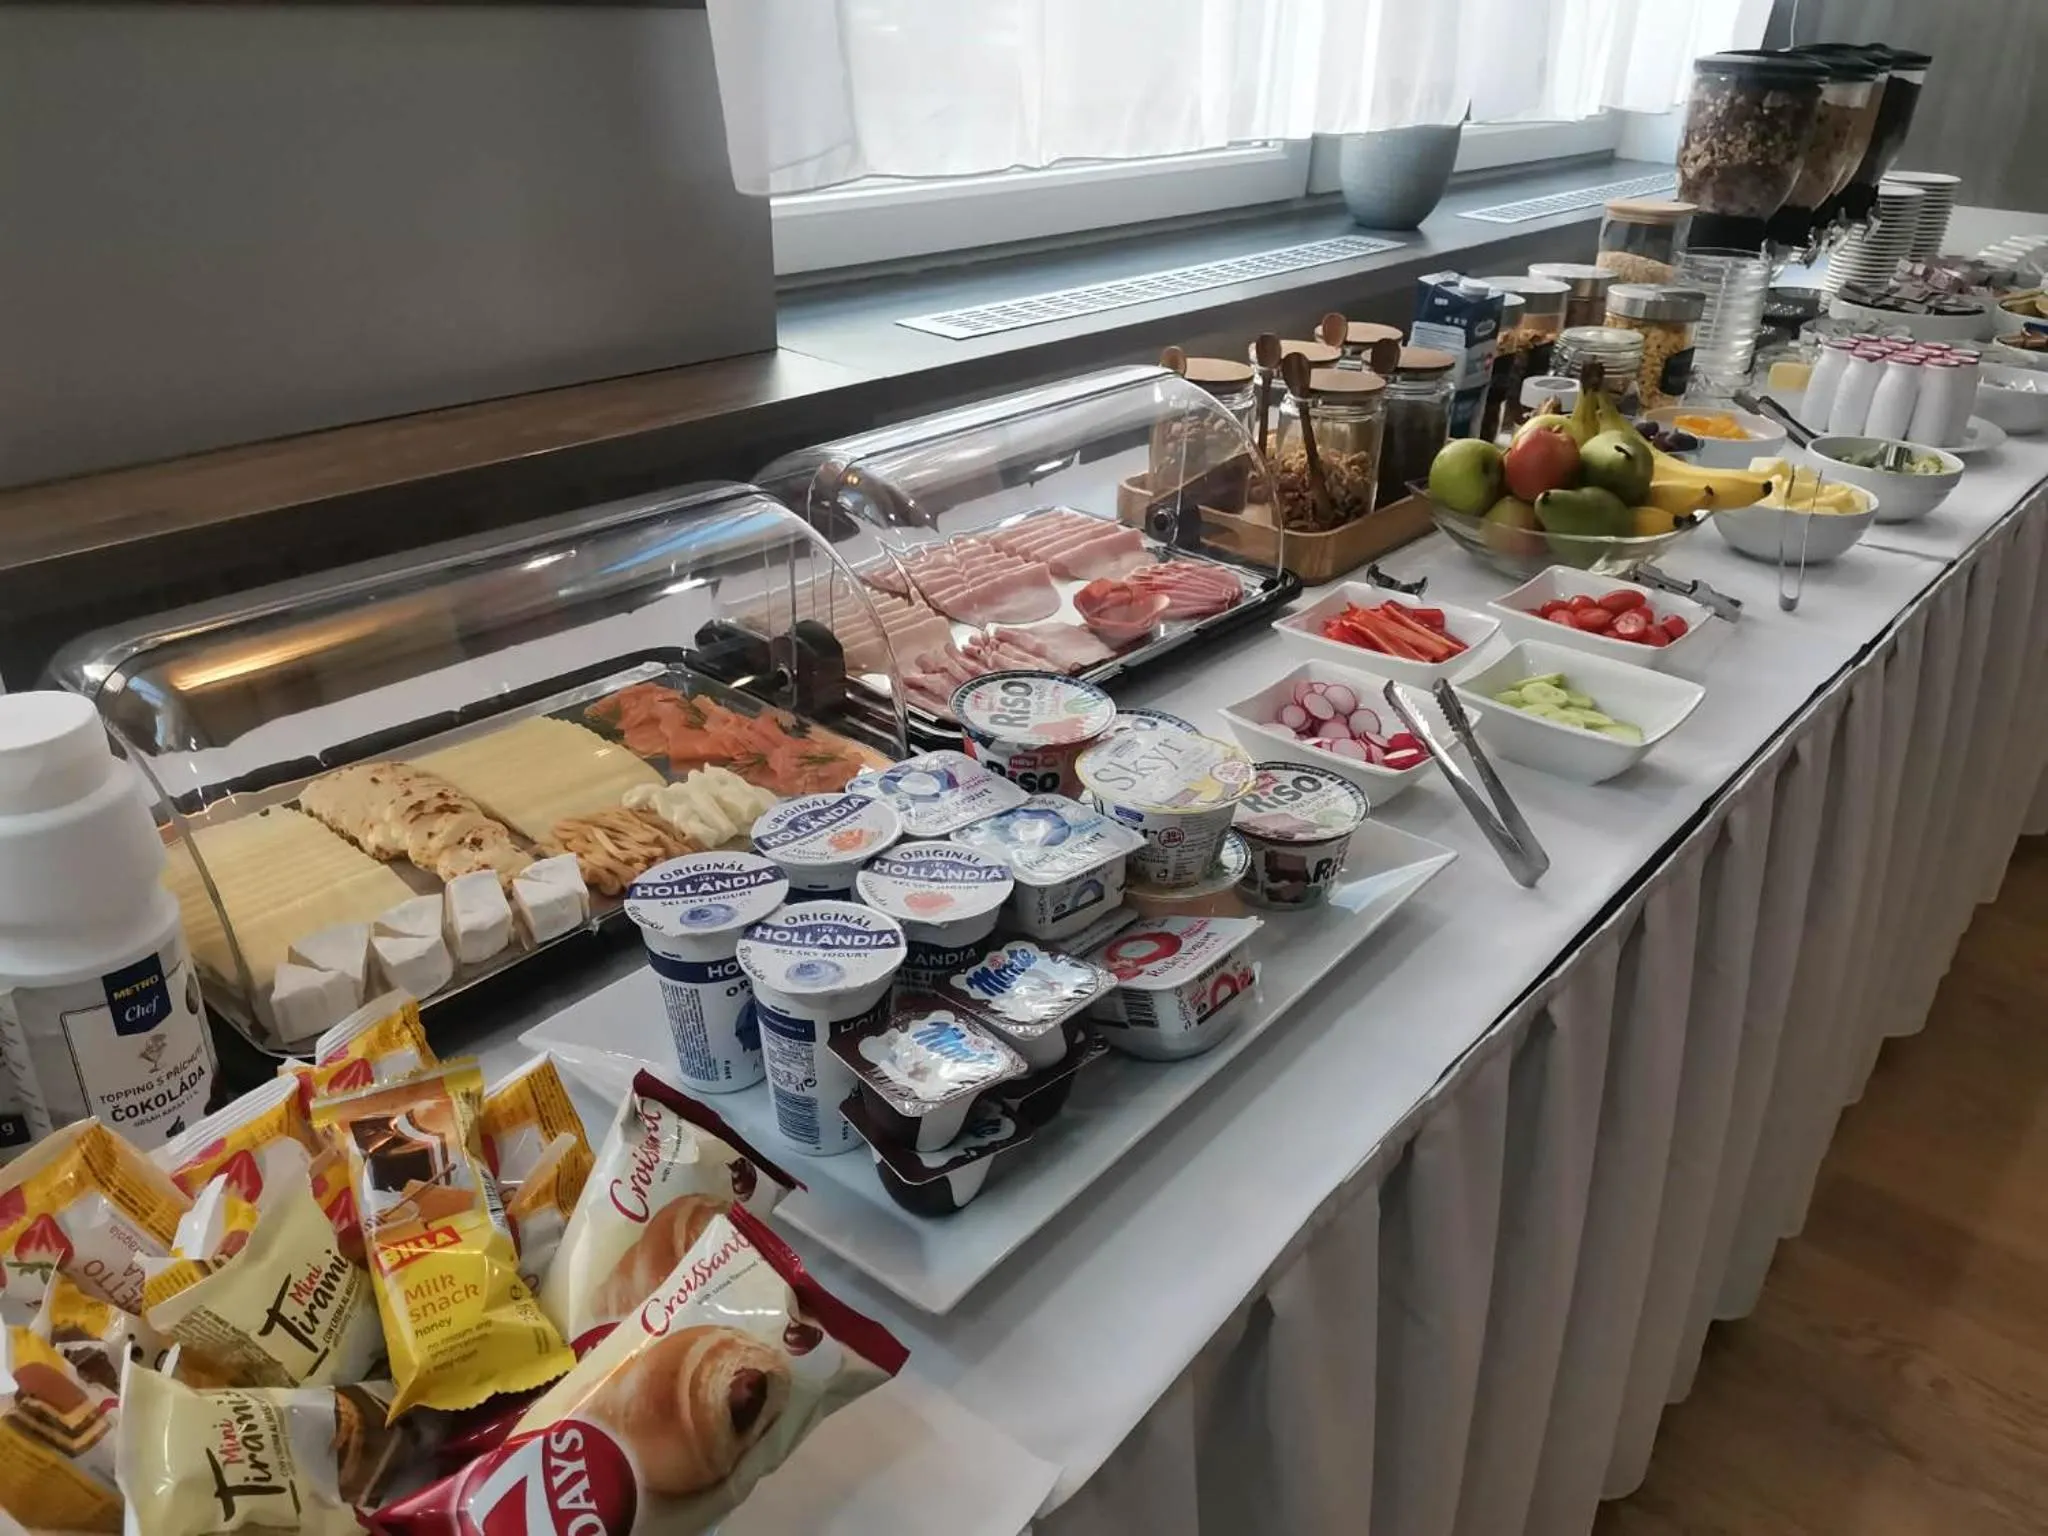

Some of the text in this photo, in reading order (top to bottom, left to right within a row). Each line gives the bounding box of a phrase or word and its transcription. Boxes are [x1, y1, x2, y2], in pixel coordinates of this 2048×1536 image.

[761, 796, 866, 848] HOLLANDIA
[635, 870, 775, 898] HOLLANDIA
[659, 860, 747, 882] ORIGINÁL
[872, 859, 1003, 881] HOLLANDIA
[753, 925, 897, 947] HOLLANDIA
[784, 911, 873, 930] ORIGINÁL
[113, 973, 160, 1001] METRO
[124, 993, 160, 1023] Chef
[98, 1080, 156, 1106] TOPPING
[110, 1064, 206, 1124] ČOKOLÁDA
[258, 1248, 349, 1354] Tirami
[287, 1262, 323, 1307] Mini
[404, 1272, 457, 1306] Milk
[640, 1230, 751, 1338] Croissant
[408, 1282, 480, 1325] snack
[211, 1417, 246, 1467] Mini
[206, 1398, 287, 1522] Tirami
